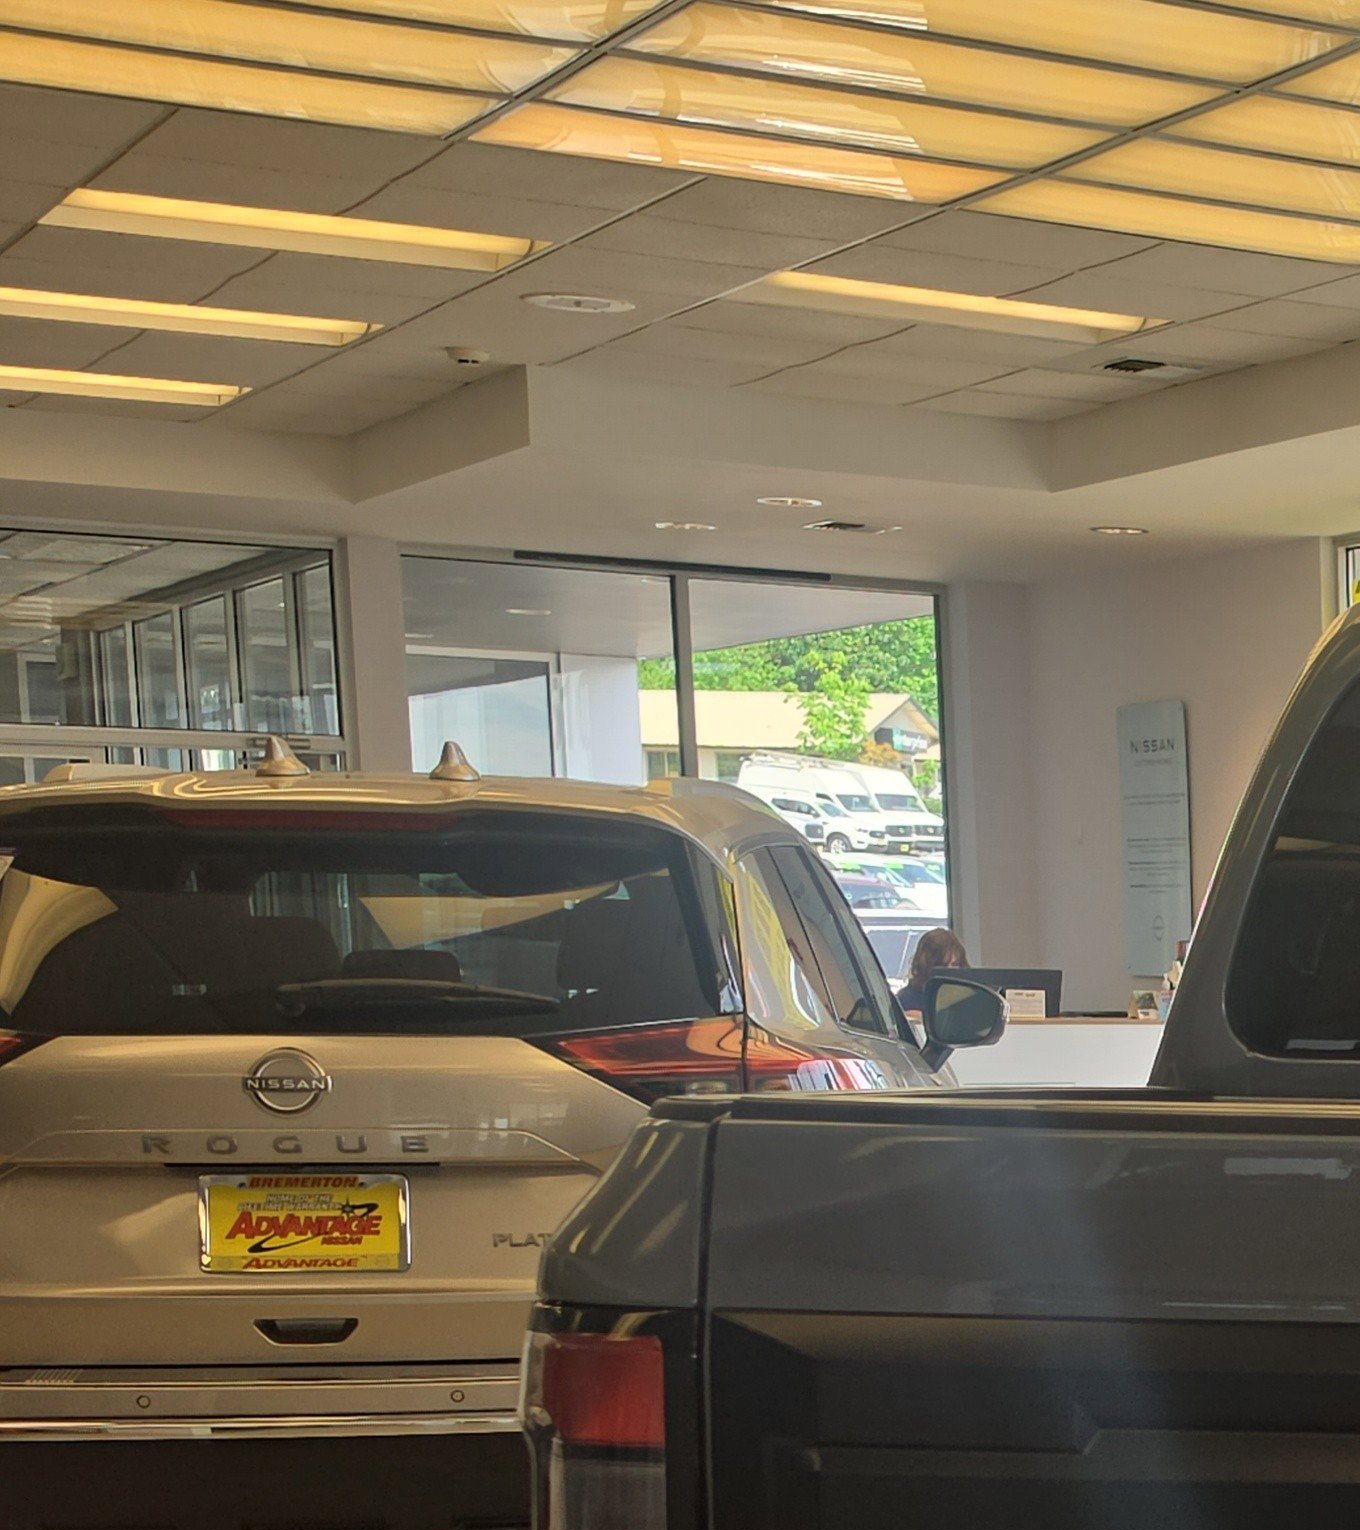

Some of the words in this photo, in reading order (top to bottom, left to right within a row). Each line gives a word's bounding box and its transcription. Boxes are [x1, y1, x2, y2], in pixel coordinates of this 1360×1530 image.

[246, 1078, 326, 1090] NISSAN
[142, 1135, 430, 1155] ROGUE
[250, 1176, 358, 1188] BREMERTON
[225, 1211, 382, 1239] ADVANTAGE
[242, 1257, 358, 1269] ADVANTAGE
